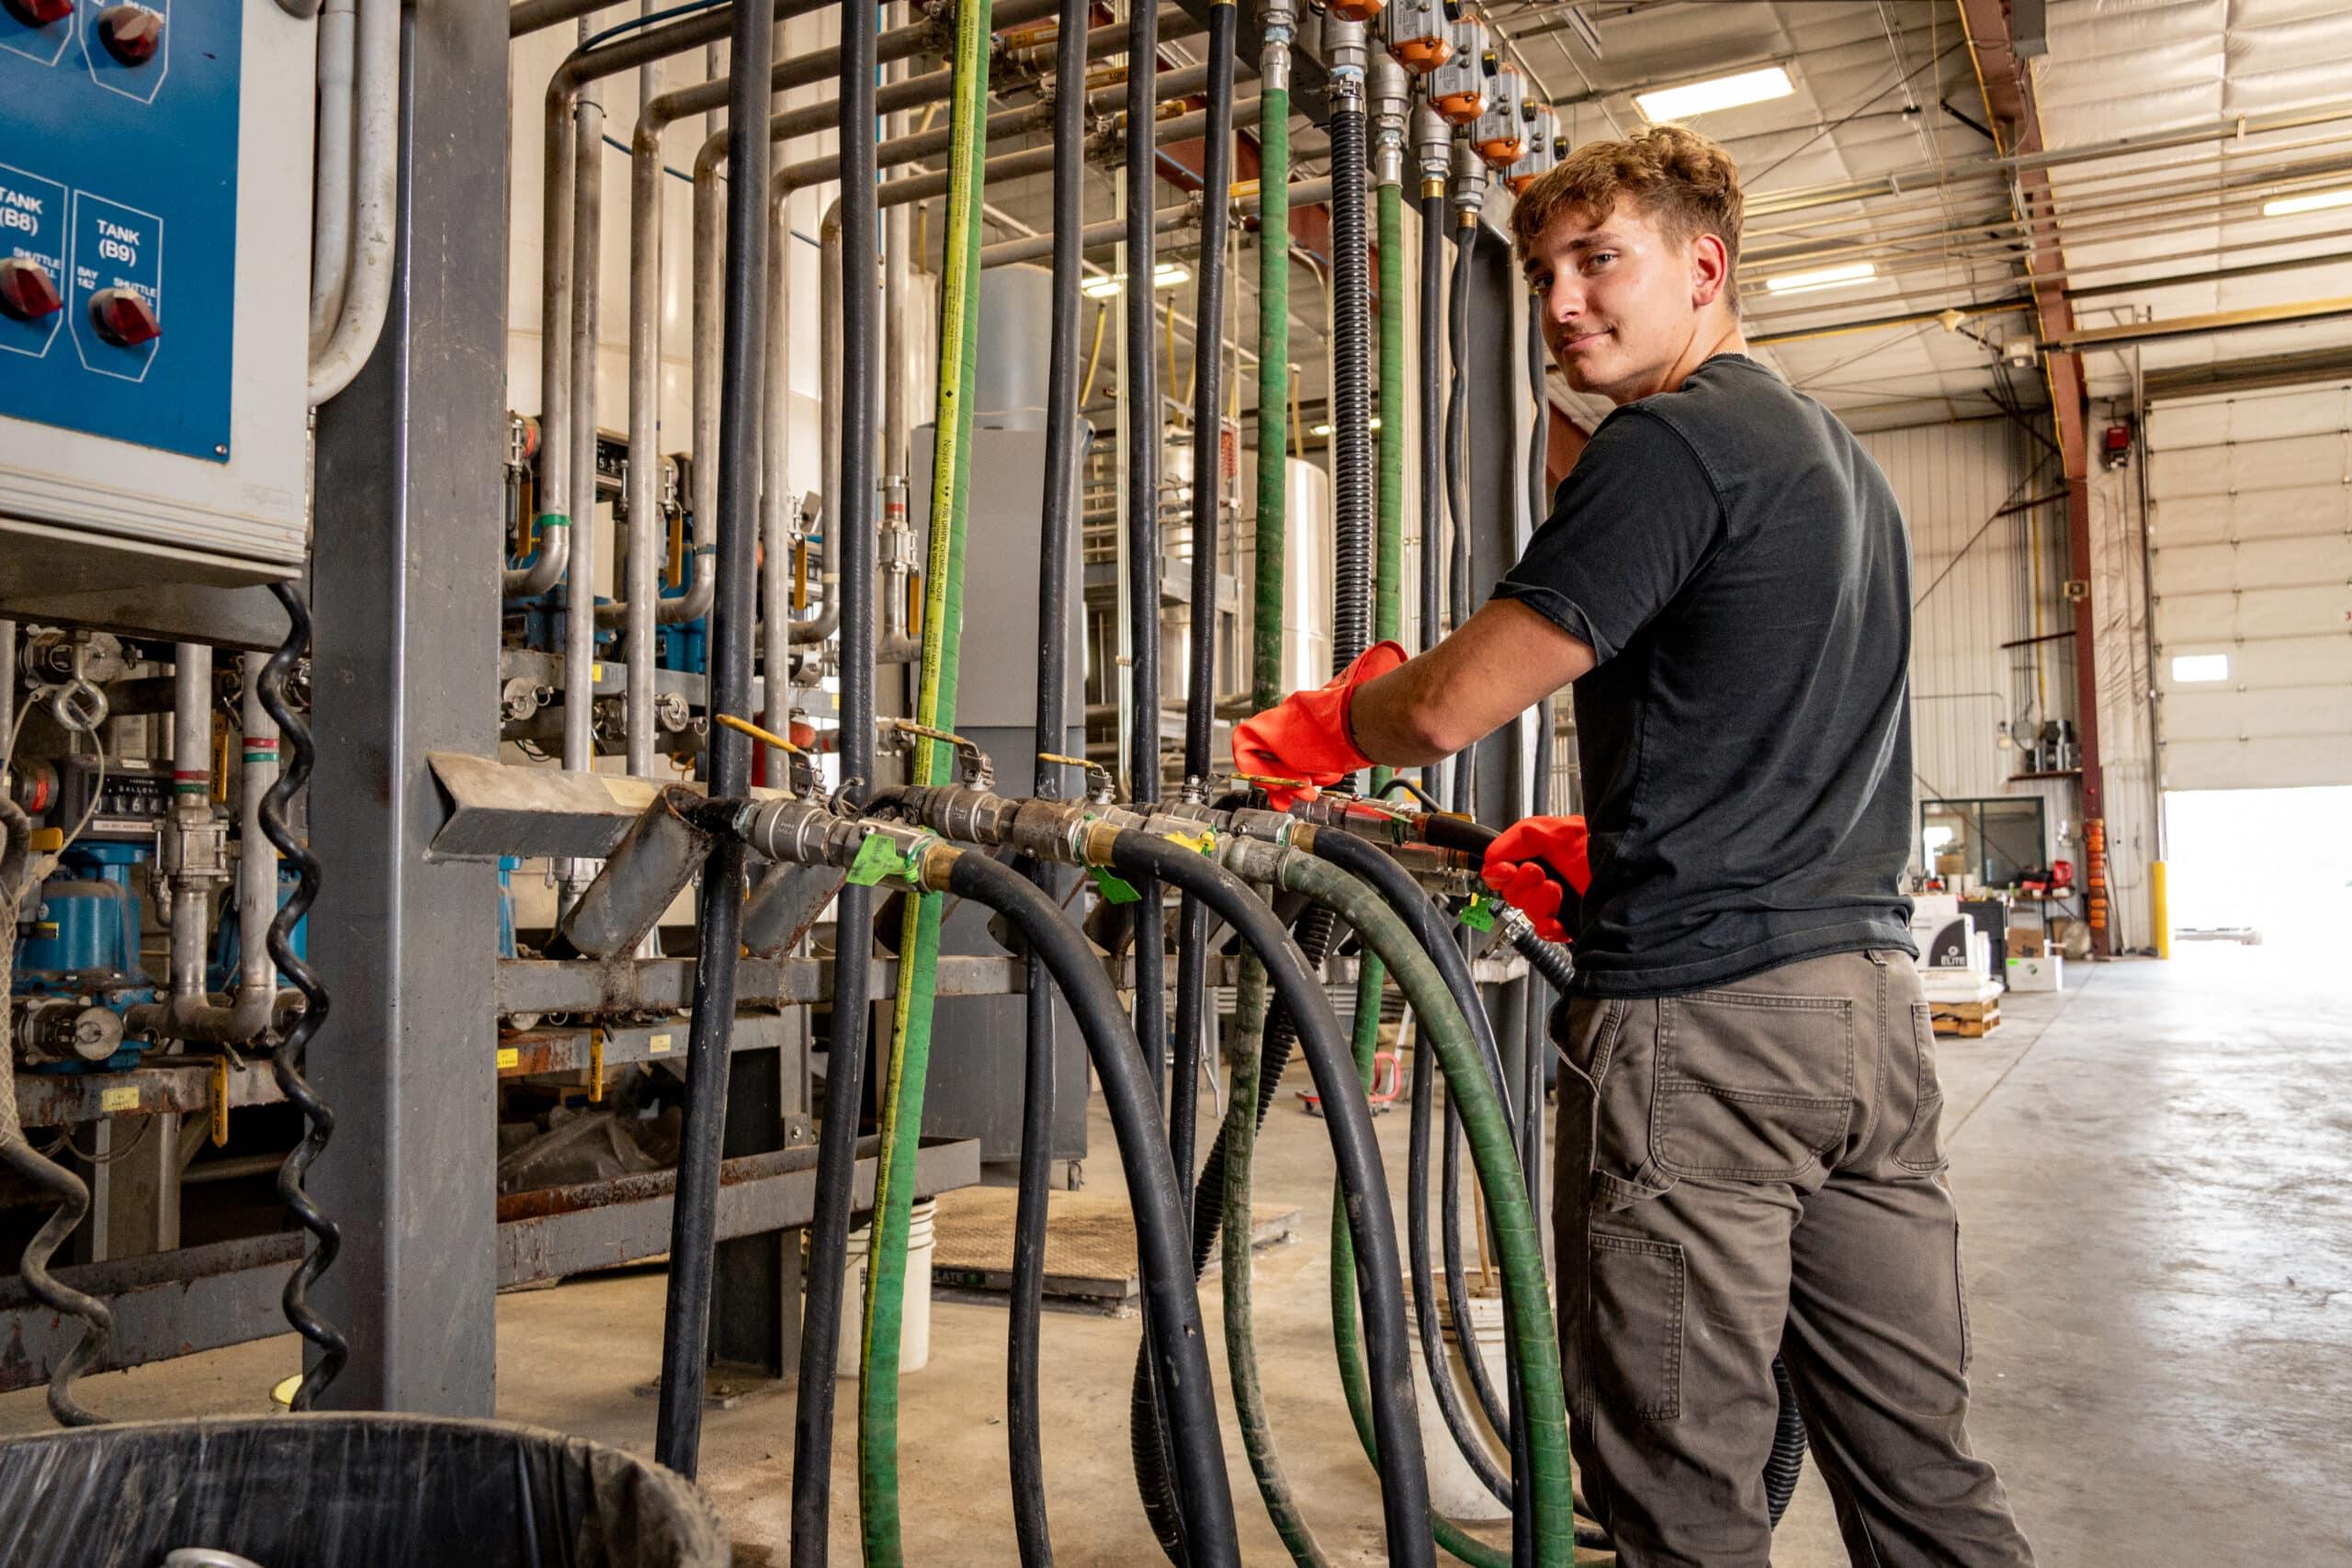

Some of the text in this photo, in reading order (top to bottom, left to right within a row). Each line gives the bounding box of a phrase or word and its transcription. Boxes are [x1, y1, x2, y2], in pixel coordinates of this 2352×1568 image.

[0, 186, 43, 215] TANK
[0, 206, 39, 237] (B8)
[96, 219, 141, 246] TANK
[98, 238, 137, 267] (B9)
[77, 265, 99, 280] BAY
[937, 544, 946, 581] CHEMICAL
[1940, 955, 1966, 966] ELITE
[876, 1189, 886, 1226] CHEMICAL
